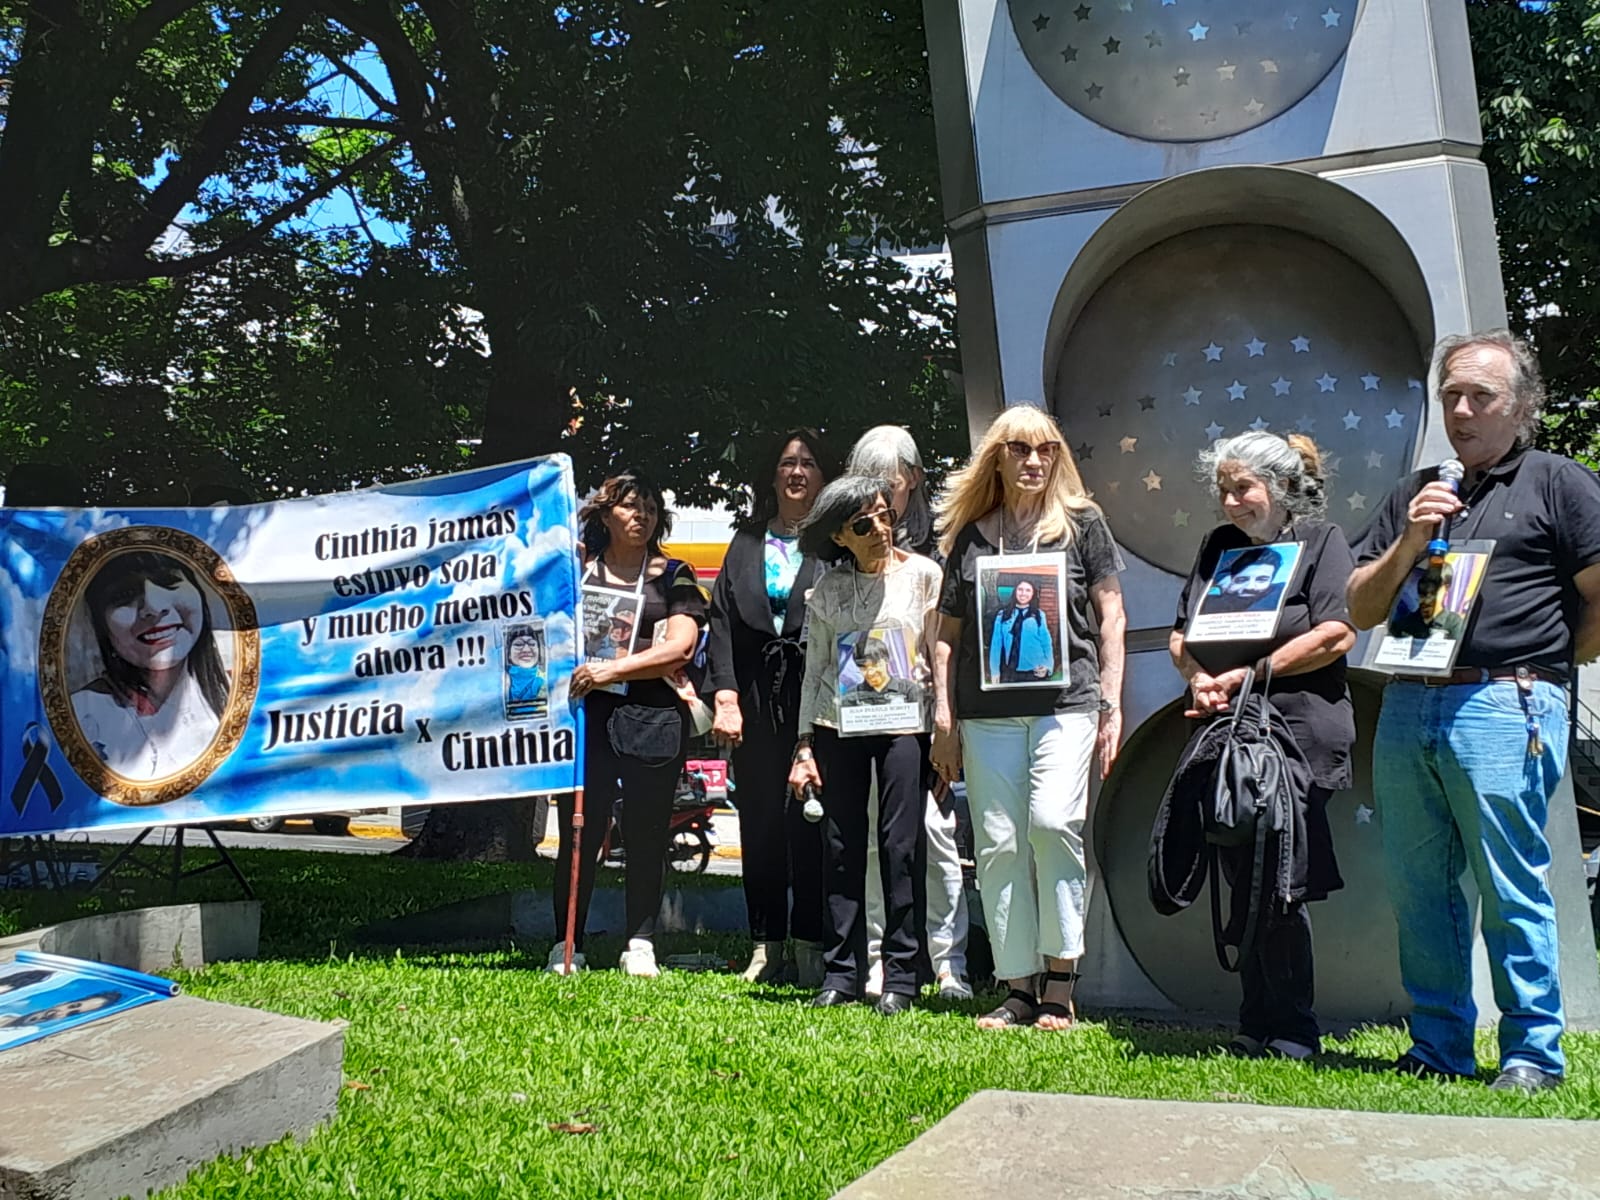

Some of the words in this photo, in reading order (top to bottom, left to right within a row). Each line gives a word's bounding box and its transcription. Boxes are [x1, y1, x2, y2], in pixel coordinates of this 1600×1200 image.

[315, 523, 417, 561] Cinthia
[426, 505, 516, 549] jamás
[333, 564, 430, 597] estuvo
[440, 552, 497, 584] sola
[301, 616, 317, 646] y
[328, 603, 425, 640] mucho
[434, 590, 533, 626] menos
[355, 643, 446, 678] ahora
[456, 635, 486, 667] !!!
[263, 700, 405, 751] Justicia
[415, 718, 433, 744] x
[441, 724, 575, 772] Cinthia
